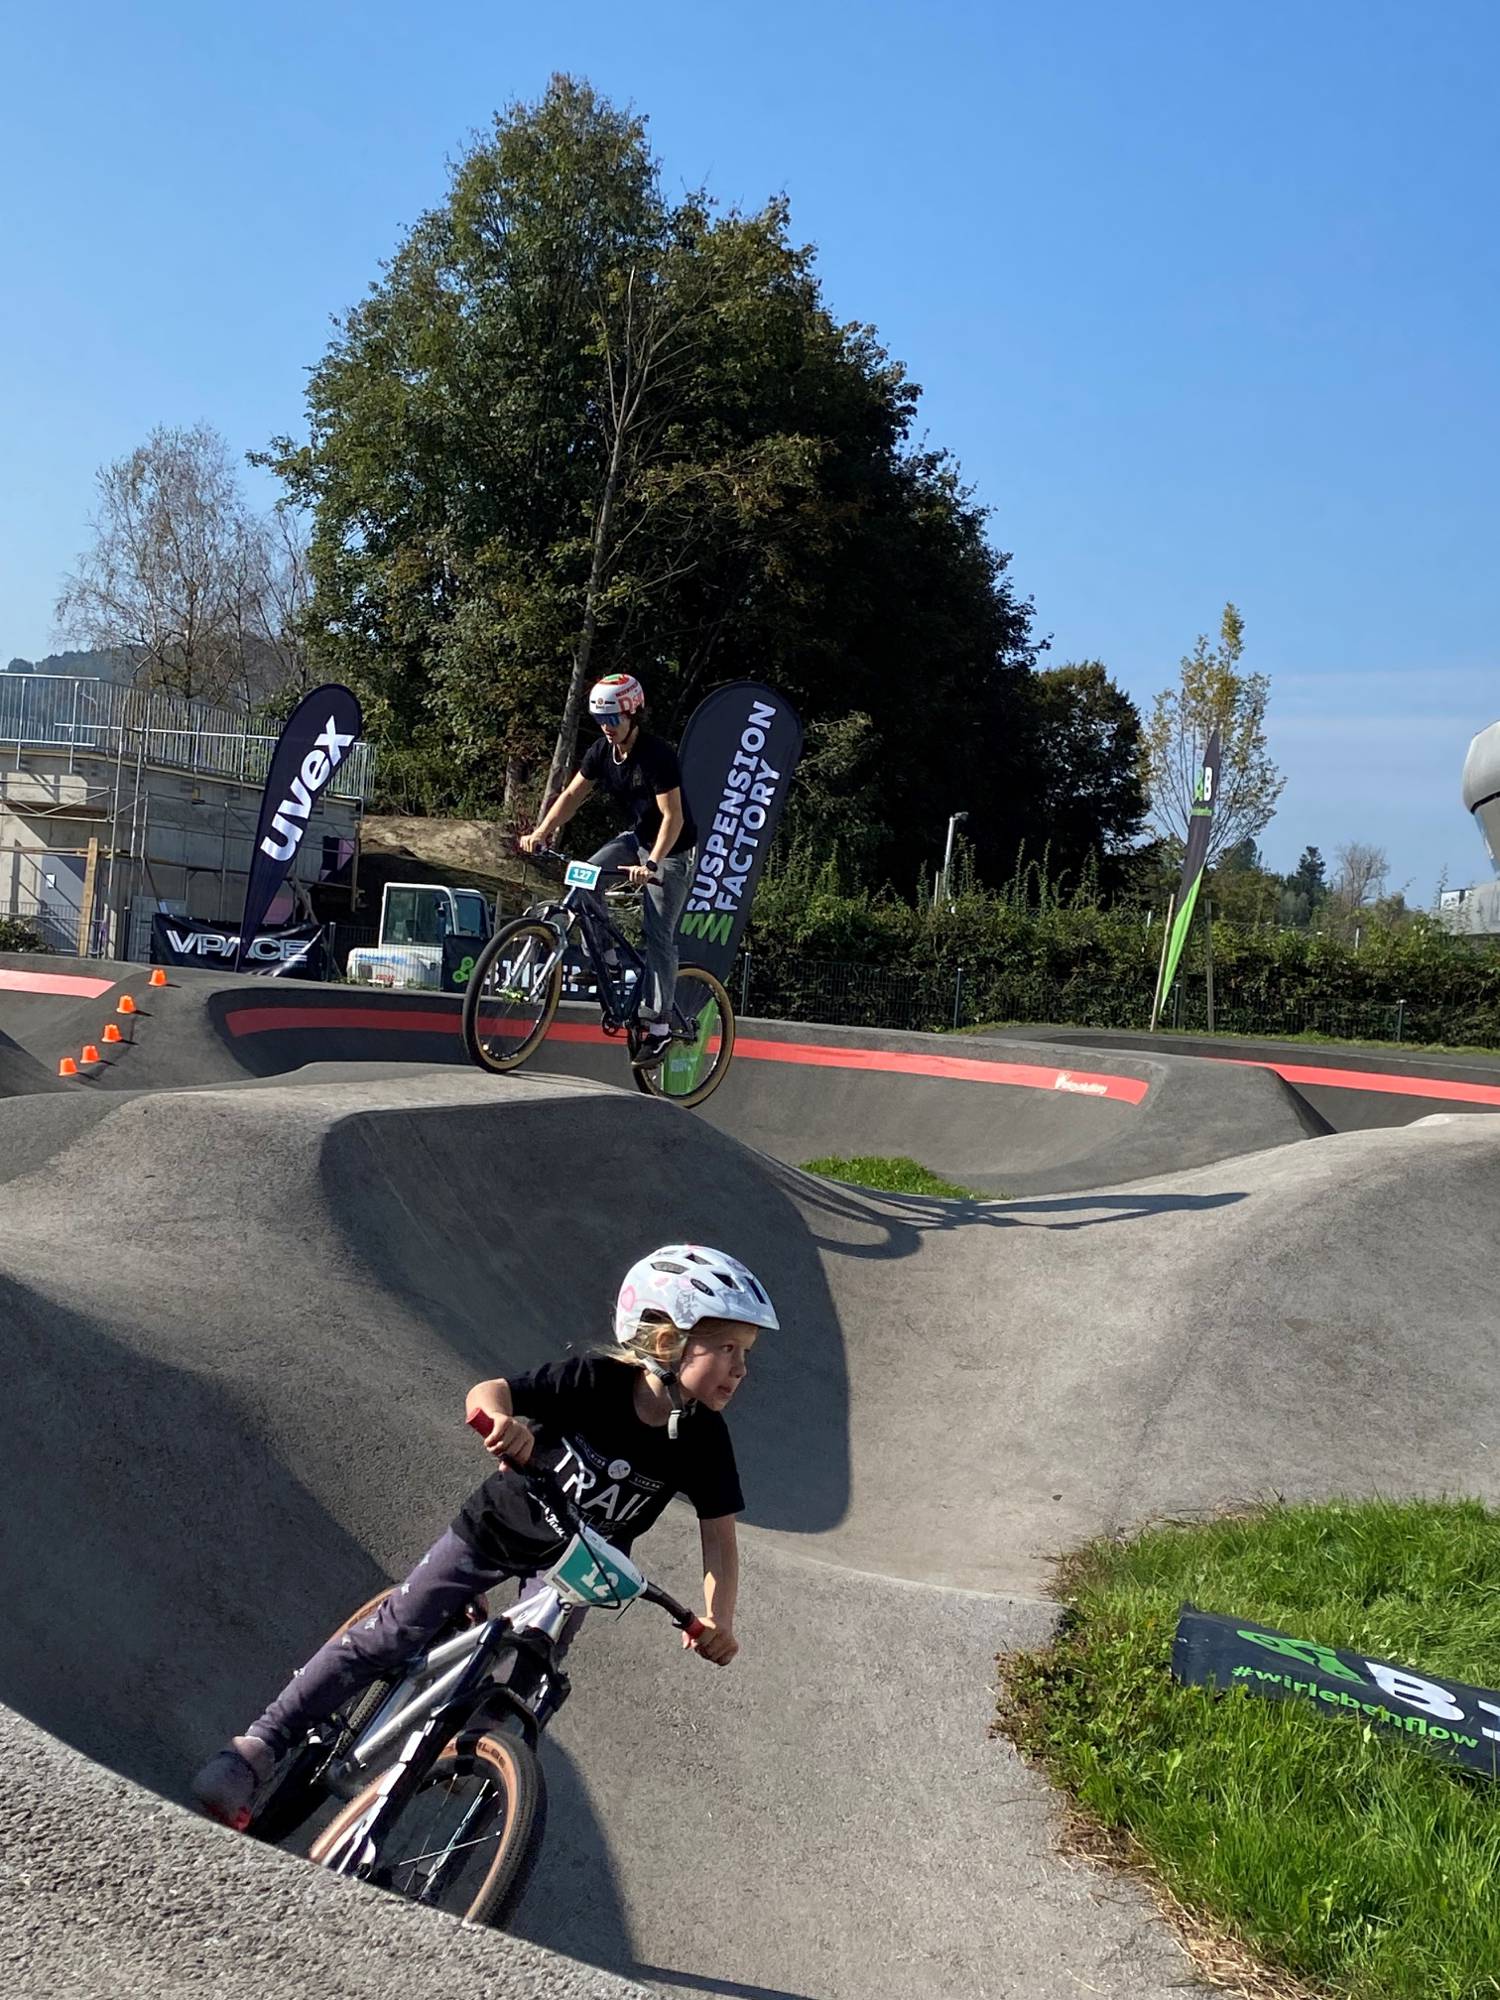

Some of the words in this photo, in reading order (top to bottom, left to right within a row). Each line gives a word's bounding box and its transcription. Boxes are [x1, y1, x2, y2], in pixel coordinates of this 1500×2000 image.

[260, 715, 355, 861] uvex
[687, 700, 777, 912] SUSPENSION
[714, 759, 780, 911] FACTORY
